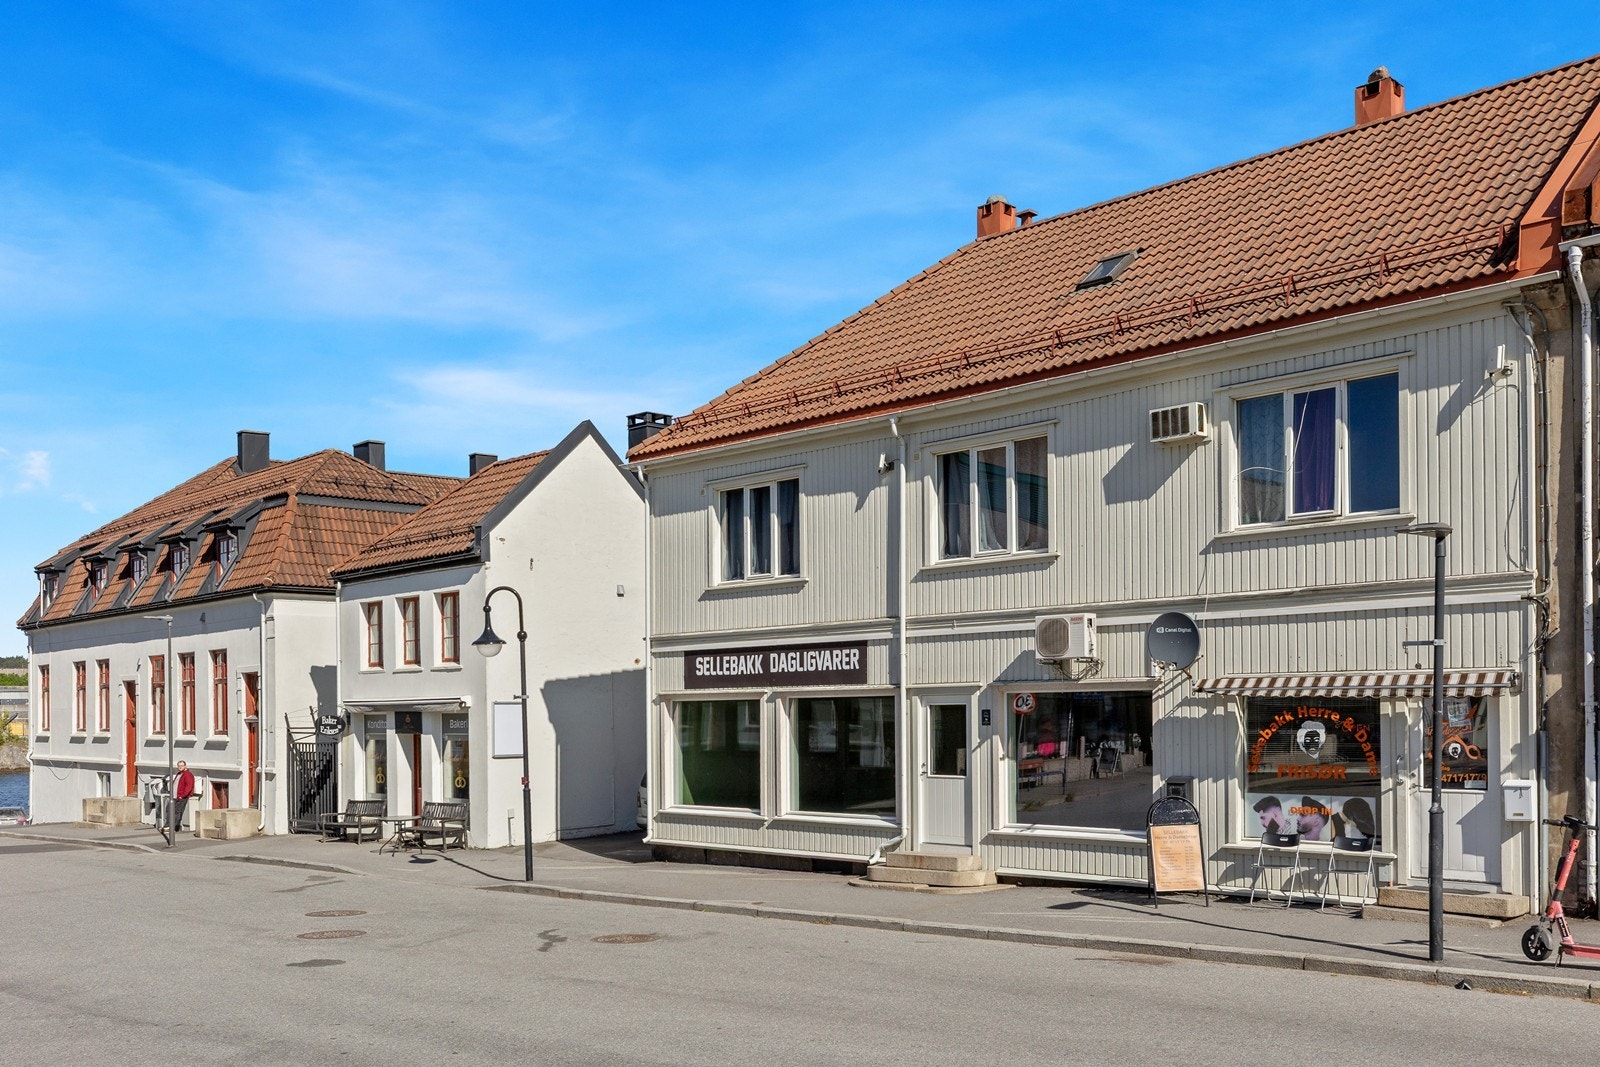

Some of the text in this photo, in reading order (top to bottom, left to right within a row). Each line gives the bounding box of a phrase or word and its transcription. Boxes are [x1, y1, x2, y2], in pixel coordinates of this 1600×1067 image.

[695, 648, 860, 676] SELLEBAKK DAGLIGVARER
[321, 715, 337, 725] Baker
[1297, 705, 1340, 721] Herre
[1343, 716, 1355, 733] &
[1354, 729, 1379, 778] Dame
[1277, 764, 1348, 780] FRISØR
[1289, 805, 1333, 816] DROP IN
